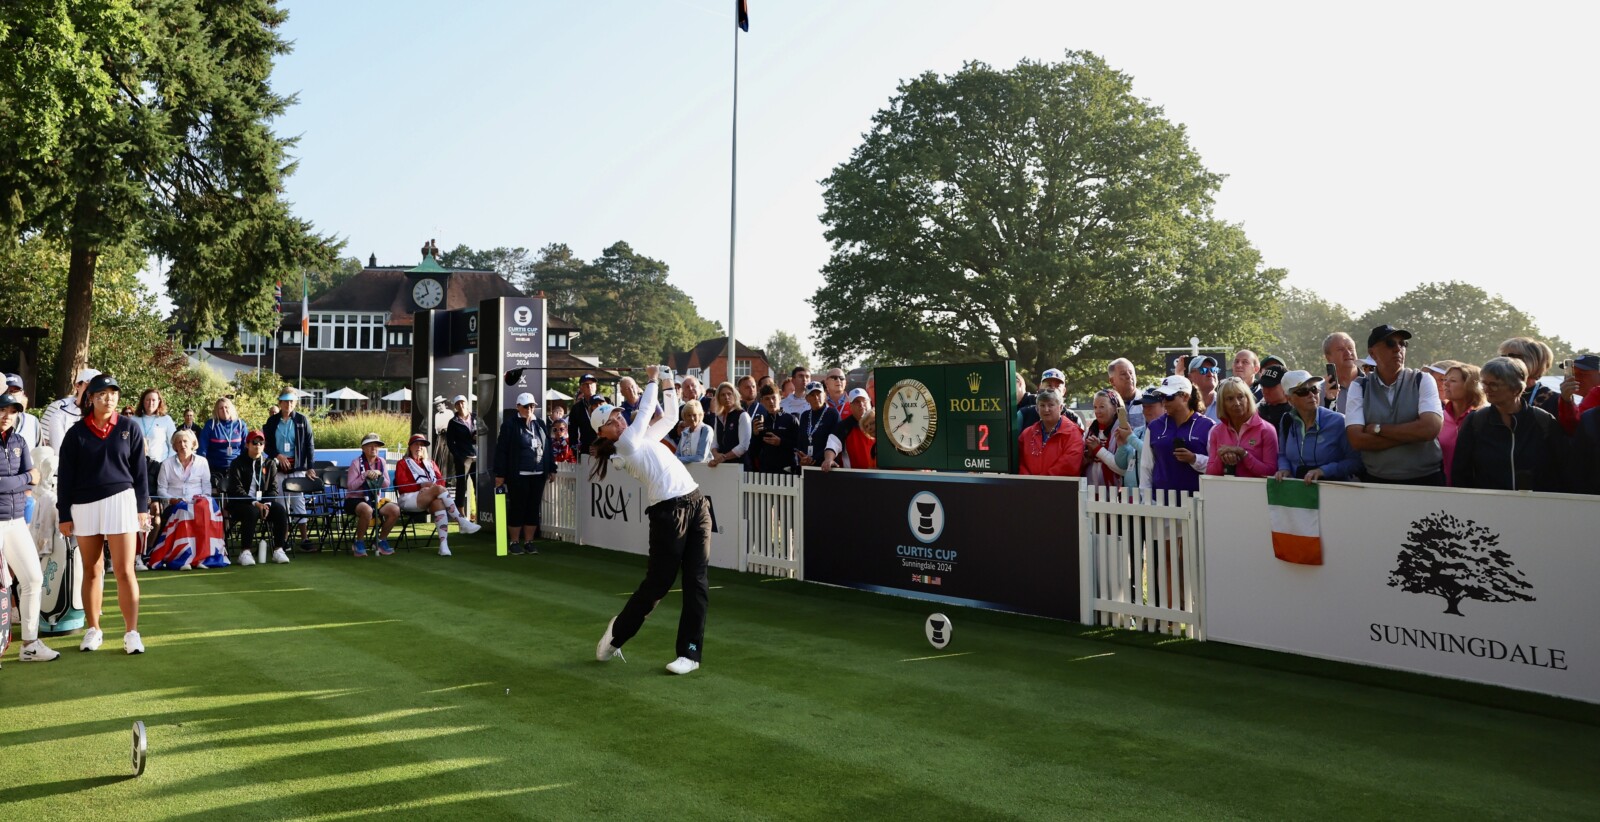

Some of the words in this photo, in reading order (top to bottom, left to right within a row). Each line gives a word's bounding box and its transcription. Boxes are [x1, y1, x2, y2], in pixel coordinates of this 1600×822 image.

[950, 398, 1002, 412] ROLEX
[978, 424, 990, 451] 2
[964, 458, 990, 469] GAME
[591, 482, 632, 522] R&A
[480, 511, 494, 523] USGA
[896, 545, 933, 558] CURTIS
[935, 549, 957, 560] CUP
[902, 558, 936, 571] Sunningdale
[937, 562, 952, 572] 2024
[1370, 623, 1568, 671] SUNNINGDALE
